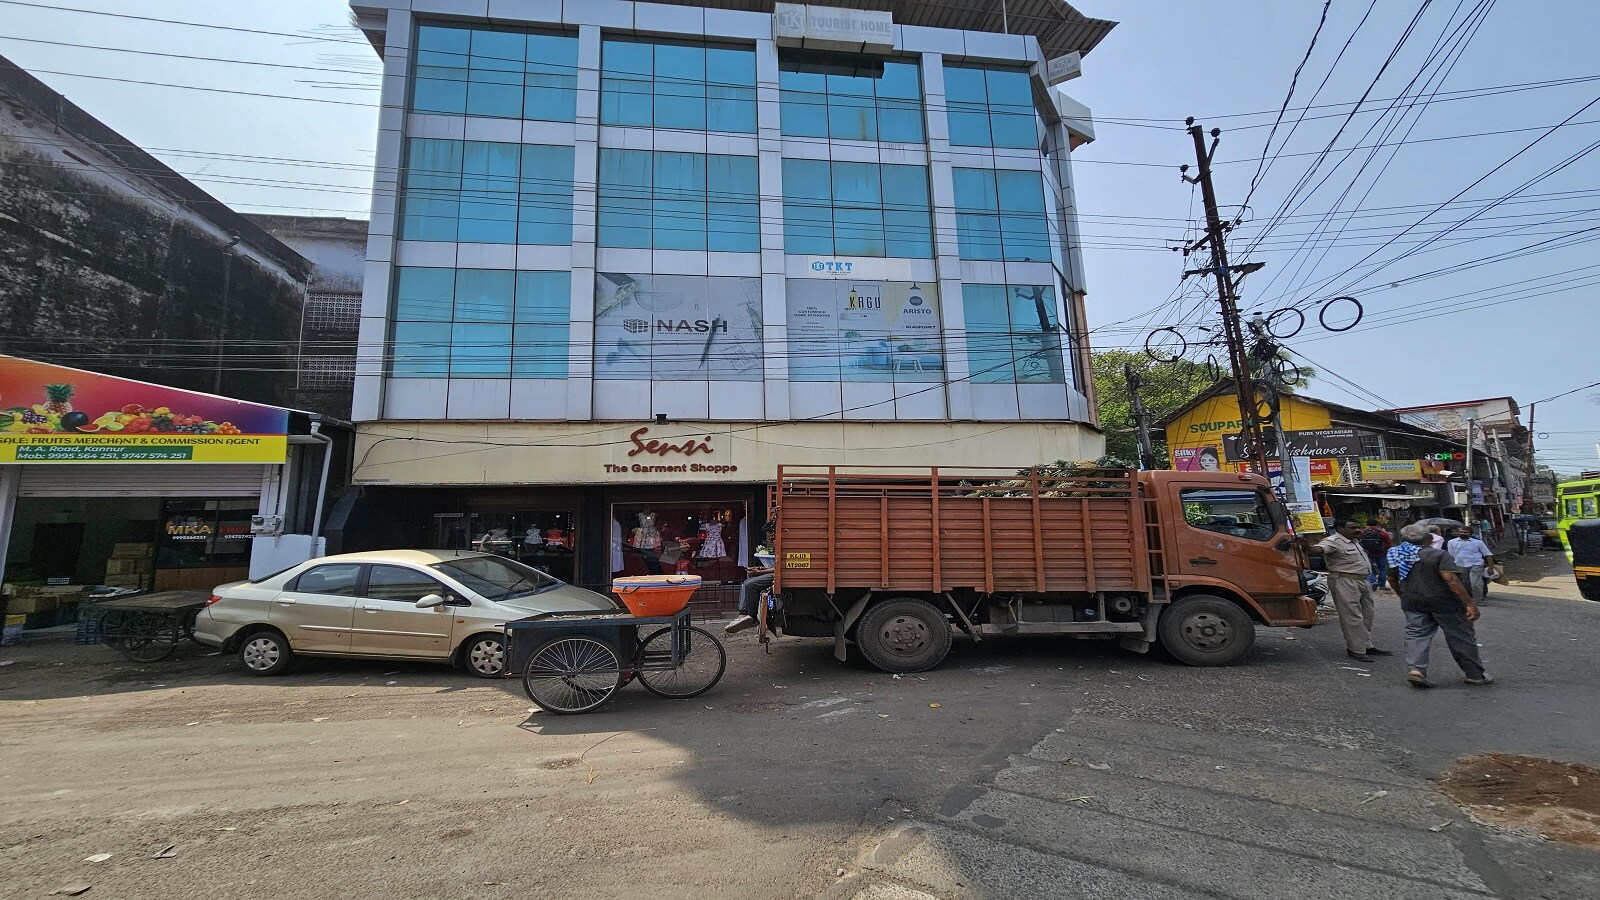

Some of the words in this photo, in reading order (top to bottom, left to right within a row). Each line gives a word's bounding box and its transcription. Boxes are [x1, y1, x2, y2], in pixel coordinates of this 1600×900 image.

[810, 16, 857, 32] TOURIST
[860, 20, 891, 33] HOME
[826, 262, 852, 271] TKT
[849, 296, 881, 308] KAGU
[657, 319, 728, 332] NASH
[74, 437, 138, 445] MERCHANT
[140, 437, 148, 445] &
[627, 426, 714, 456] Sensi
[49, 445, 81, 453] Road,
[1174, 449, 1196, 458] Silky
[100, 452, 119, 460] 251,
[603, 464, 628, 473] The
[631, 463, 687, 473] Garment
[690, 463, 738, 473] Shoppe
[167, 525, 213, 535] MKA
